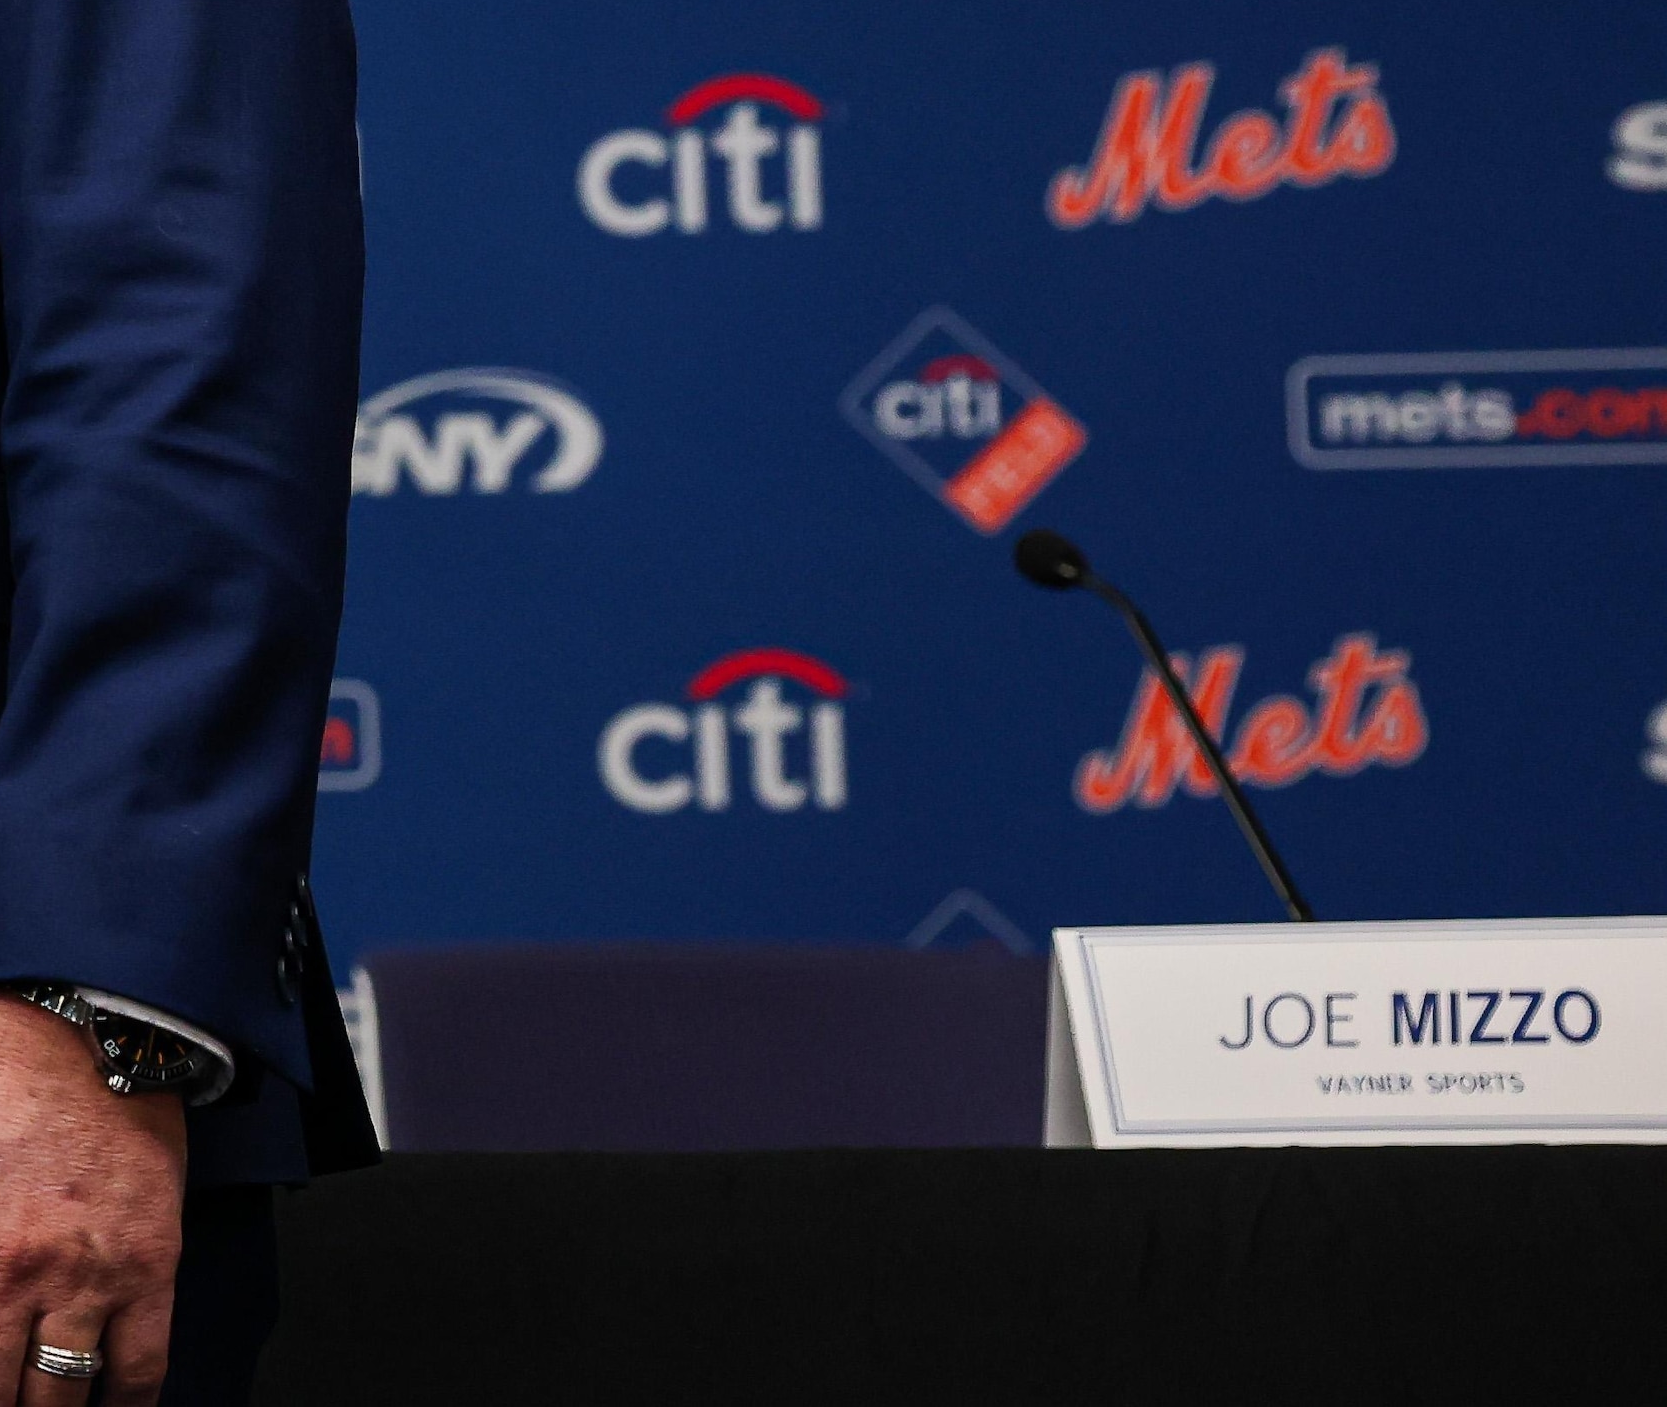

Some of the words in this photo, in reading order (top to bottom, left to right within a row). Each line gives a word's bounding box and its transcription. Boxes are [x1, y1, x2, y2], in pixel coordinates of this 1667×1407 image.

[575, 100, 824, 239] citi
[1047, 45, 1397, 230] Mets
[871, 370, 1003, 442] citi
[595, 675, 849, 815] citi
[1073, 630, 1430, 813] Mets
[1218, 991, 1361, 1050] JOE
[1391, 988, 1602, 1047] MIZZO
[1425, 1072, 1526, 1095] SPORTS
